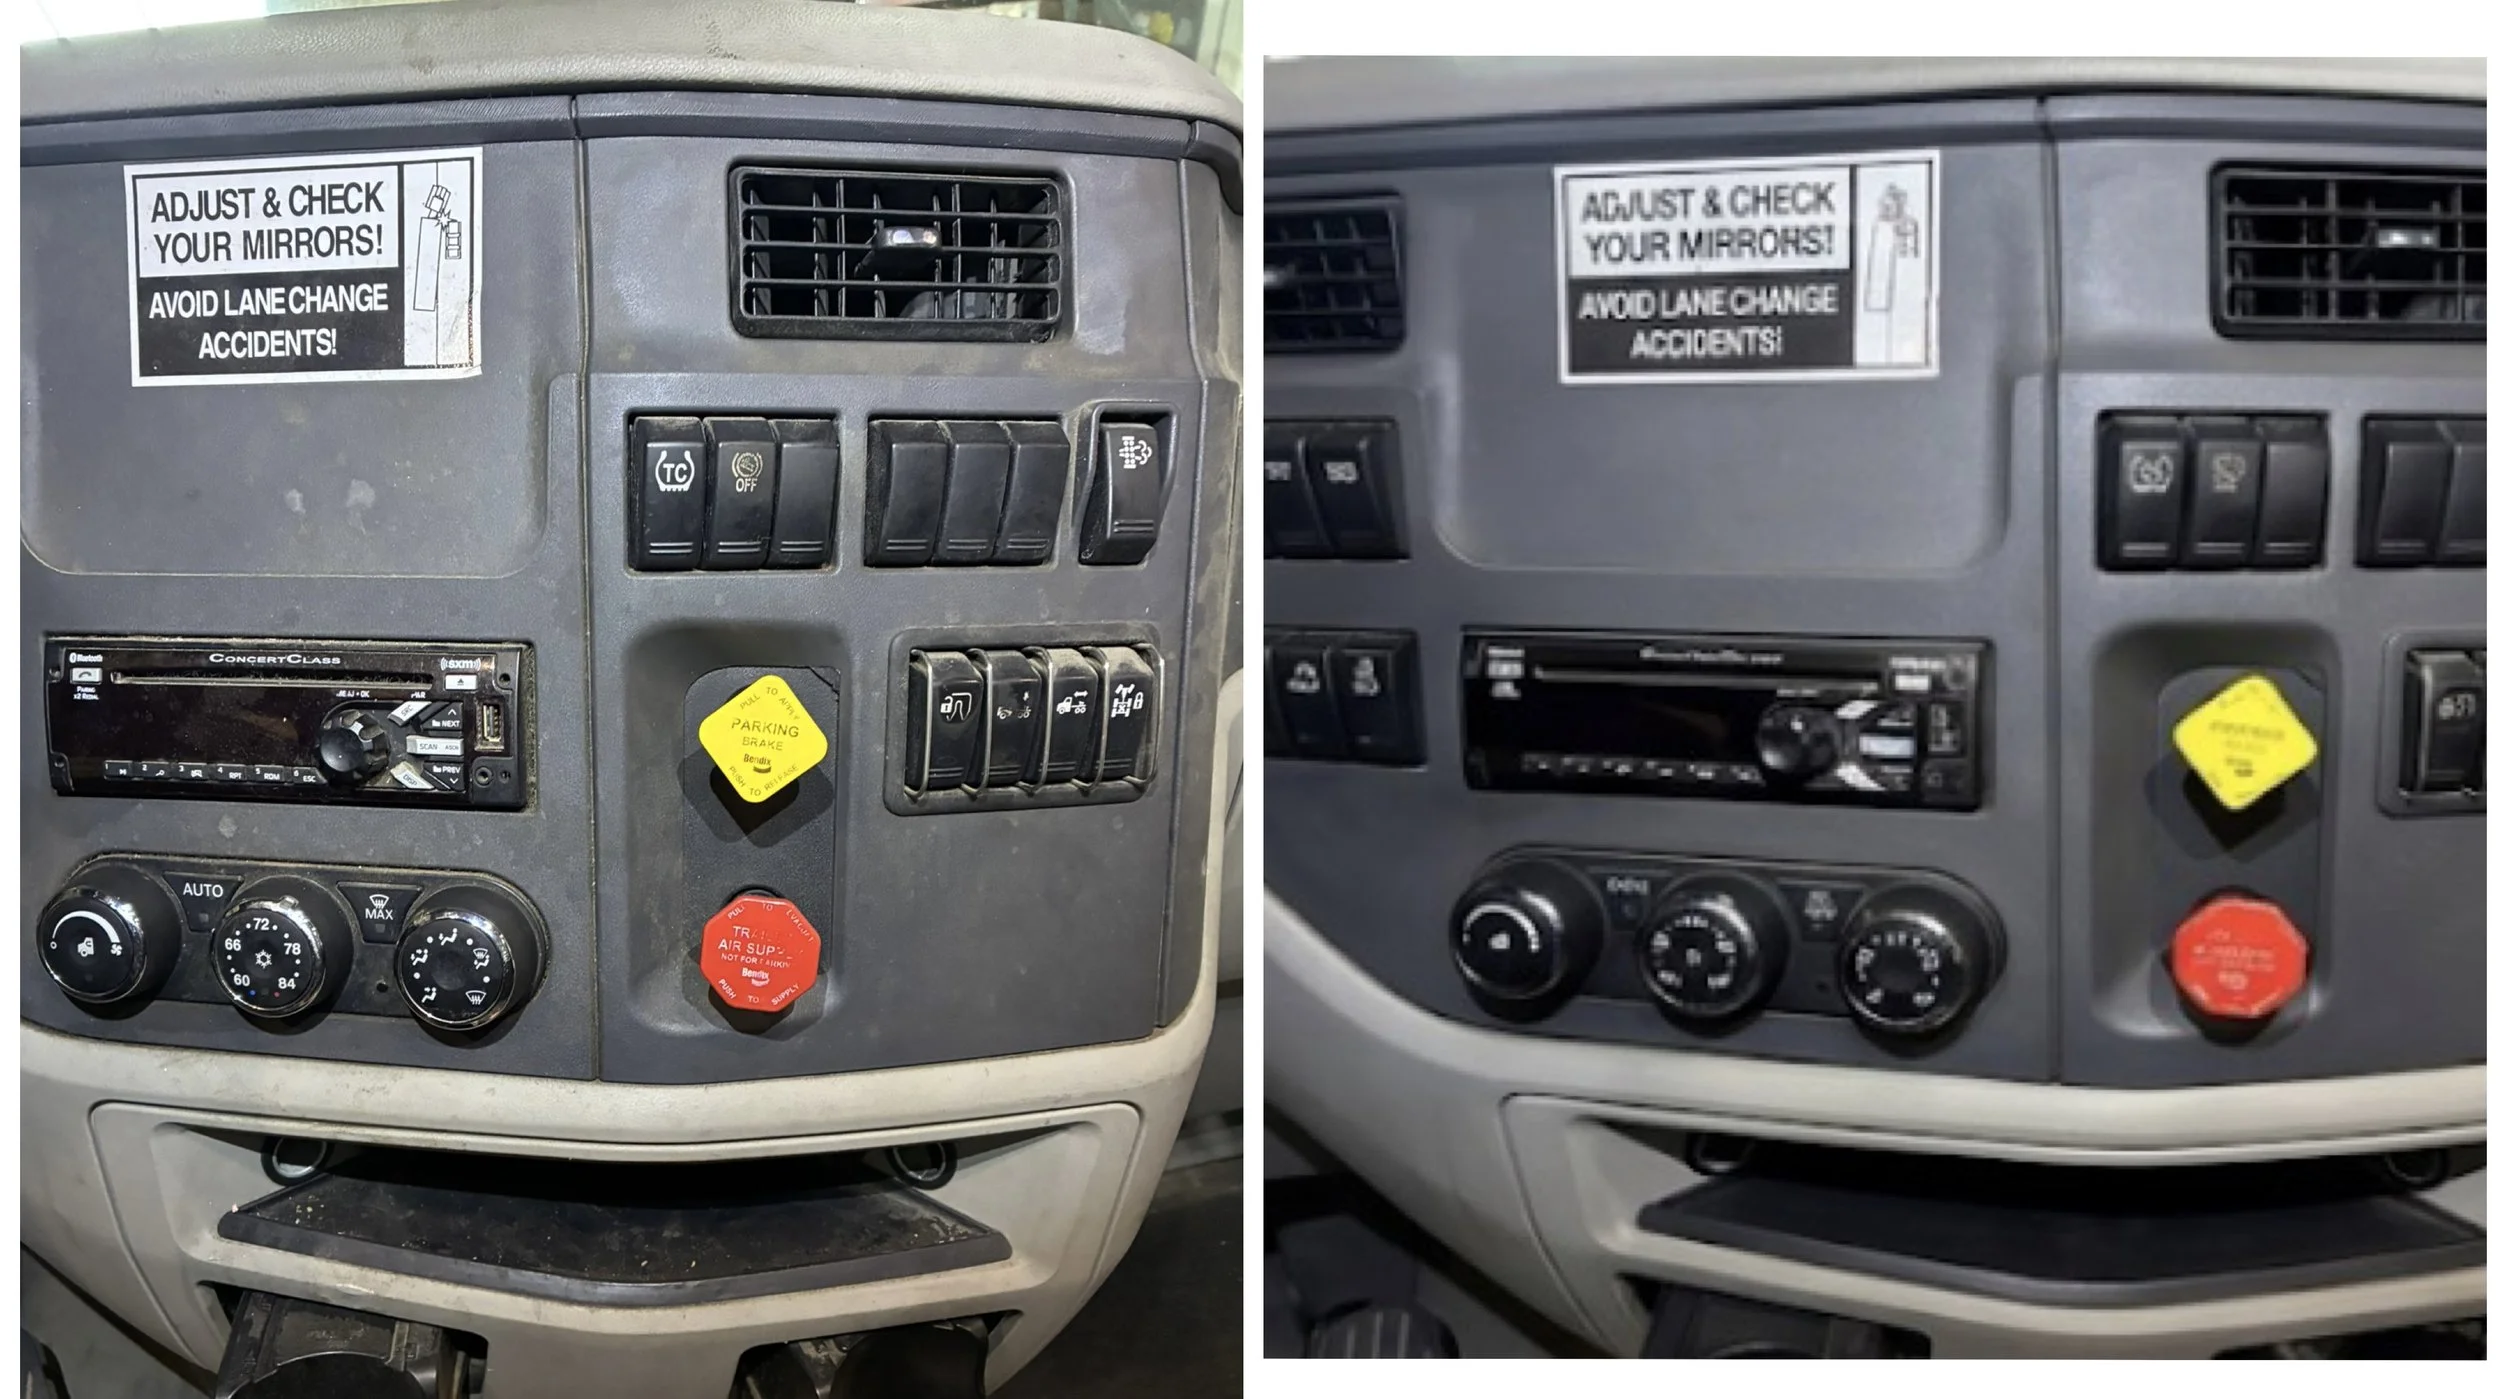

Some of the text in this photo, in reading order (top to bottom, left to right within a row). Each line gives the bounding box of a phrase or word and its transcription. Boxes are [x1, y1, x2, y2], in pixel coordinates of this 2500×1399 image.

[151, 181, 384, 223] ADJUST & CHECK
[1581, 182, 1836, 222] ADJUST & CHECK
[154, 224, 383, 264] YOUR MIRRORS!
[1583, 230, 1670, 263] YOUR
[149, 283, 388, 319] AVOID LANE CHANGE
[1578, 284, 1839, 320] AVOID LANE CHANGE
[199, 329, 337, 359] ACCIDENTS!
[662, 463, 688, 483] TC
[735, 478, 758, 493] OFF
[766, 686, 778, 696] TO
[441, 720, 460, 728] NEXT
[731, 718, 800, 738] PARKING
[741, 736, 784, 751] BRAKE
[229, 772, 242, 780] RPT
[303, 775, 316, 783] ESC
[749, 788, 762, 797] TO
[183, 882, 224, 898] AUTO
[365, 908, 394, 921] MAX
[253, 917, 270, 931] 72
[224, 937, 241, 951] 66
[283, 942, 301, 956] 78
[717, 938, 742, 952] AIR
[721, 952, 739, 962] NOT
[740, 955, 758, 965] FOR
[233, 973, 251, 987] 60
[277, 976, 296, 990] 84
[718, 978, 737, 999] PUSH
[747, 995, 760, 1004] TO
